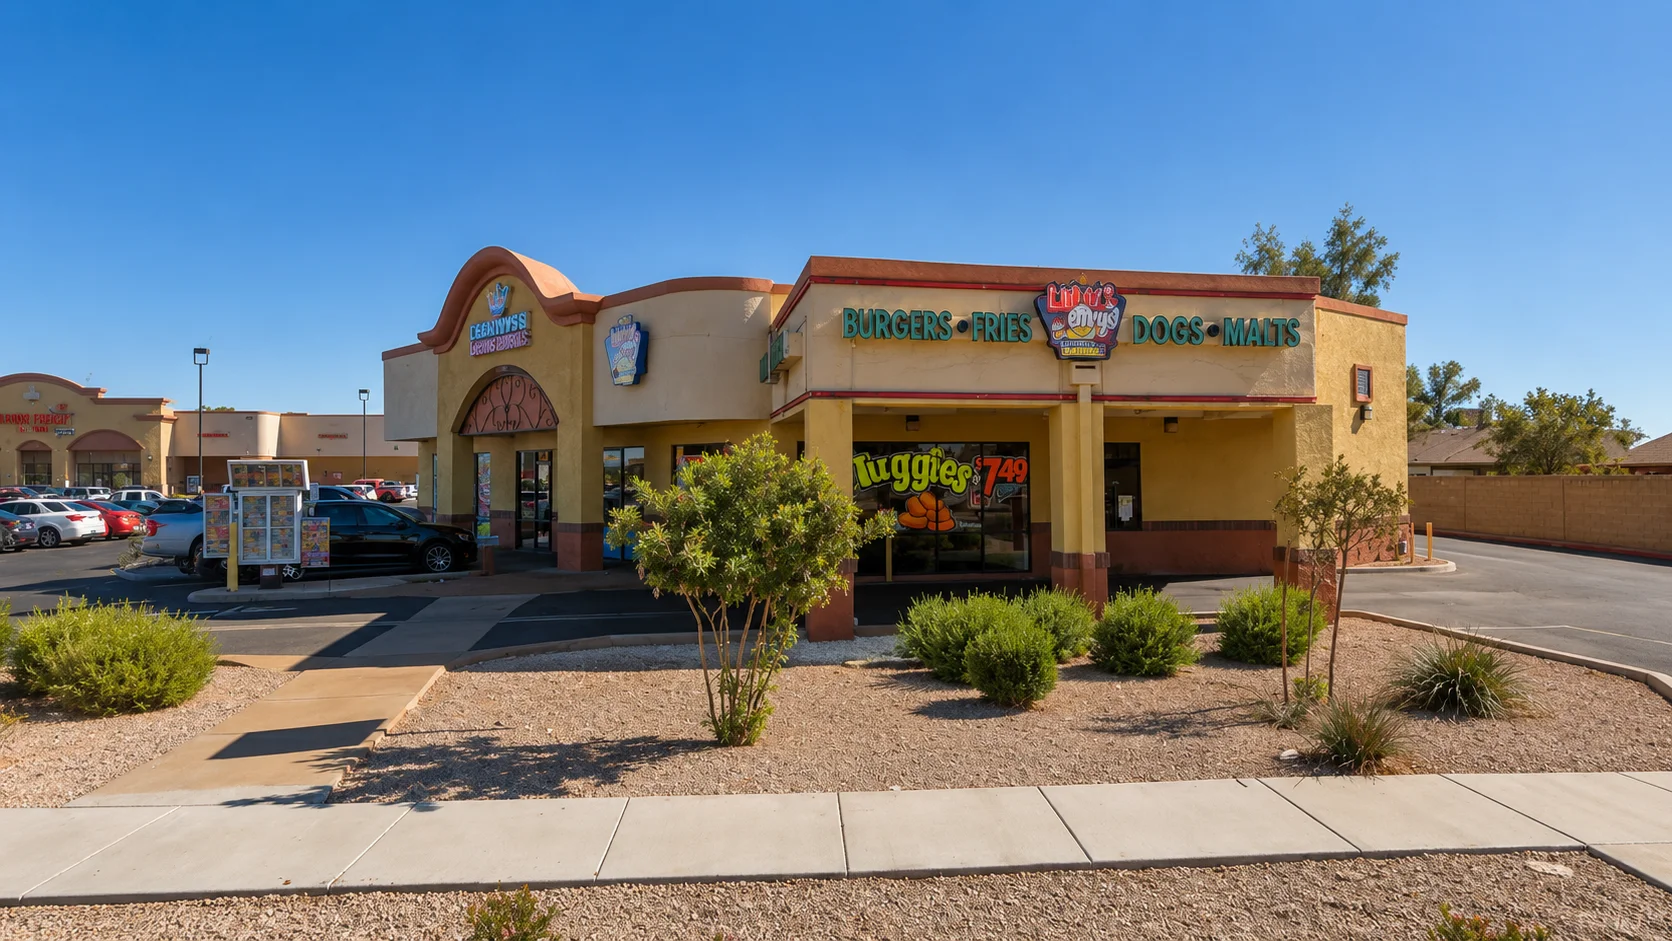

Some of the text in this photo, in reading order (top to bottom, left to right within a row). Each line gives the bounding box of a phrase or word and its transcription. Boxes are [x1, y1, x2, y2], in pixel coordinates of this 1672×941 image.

[843, 308, 1033, 343] BURGERS FRIES
[1133, 315, 1301, 347] DOGS MALTS
